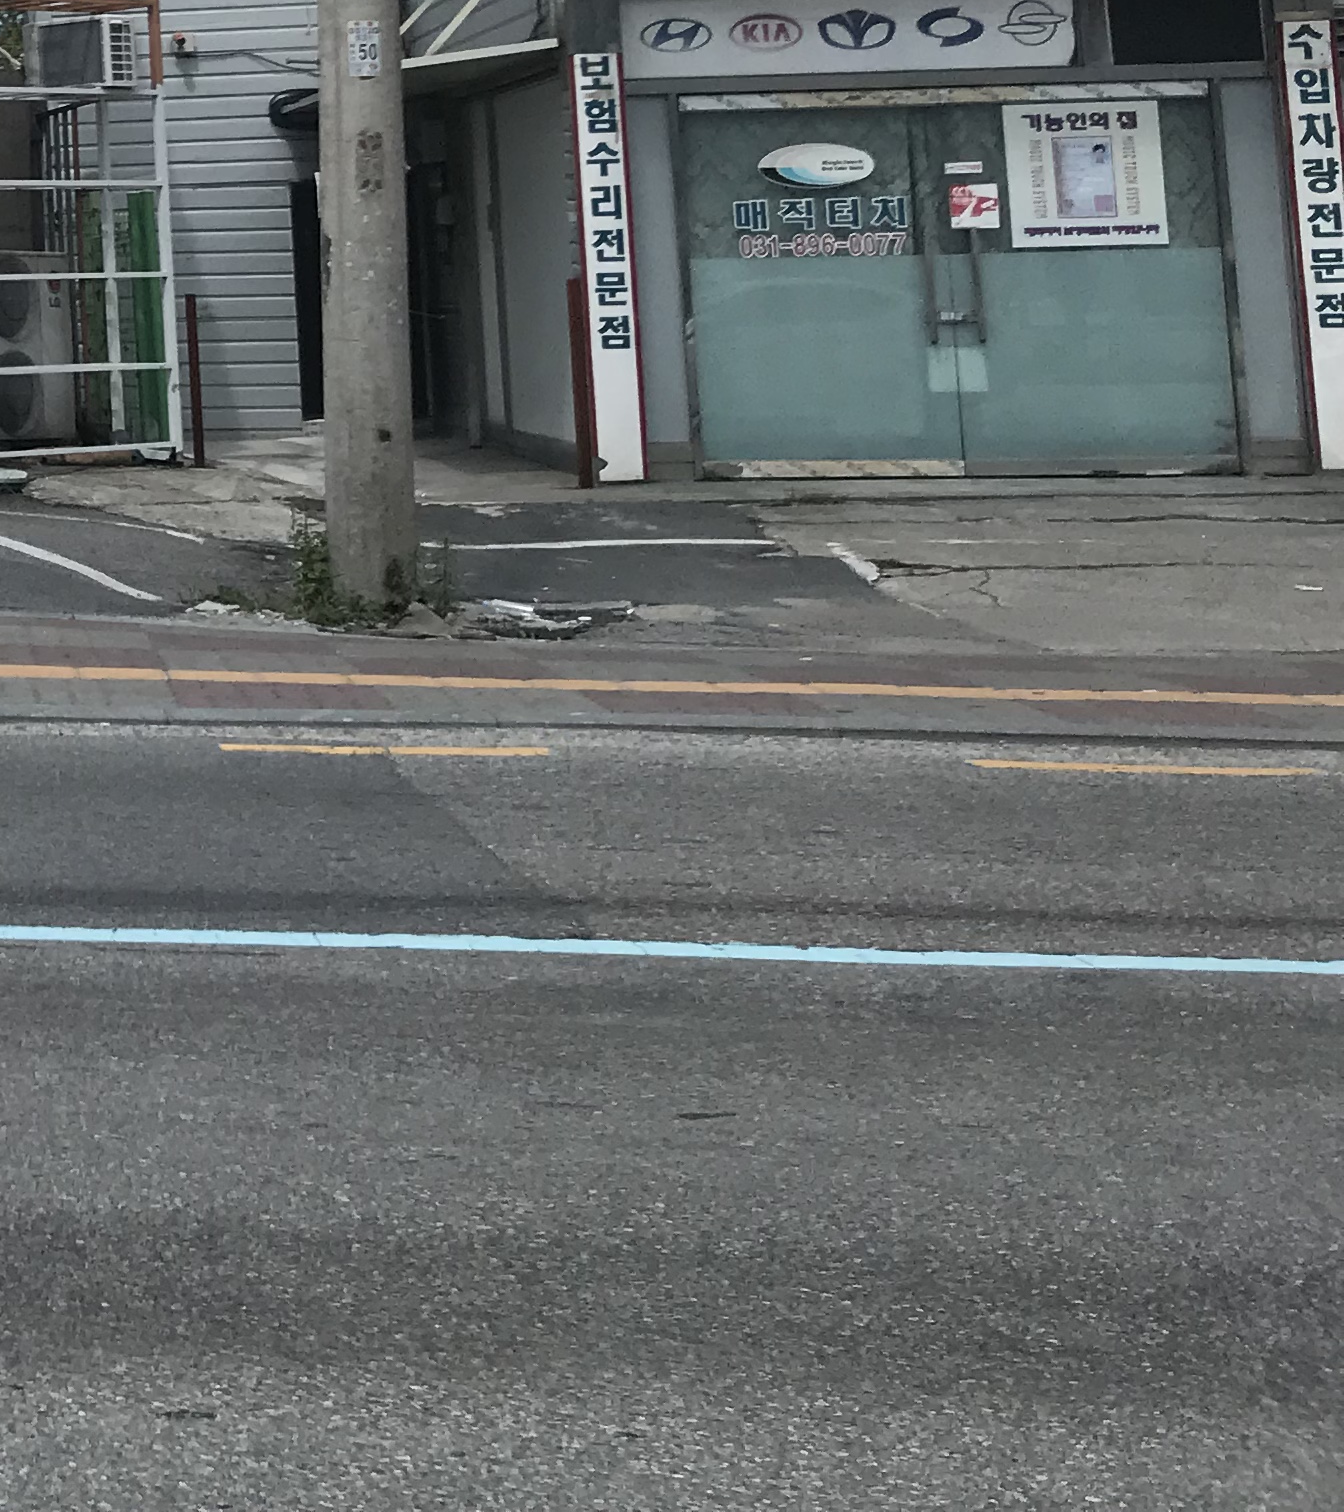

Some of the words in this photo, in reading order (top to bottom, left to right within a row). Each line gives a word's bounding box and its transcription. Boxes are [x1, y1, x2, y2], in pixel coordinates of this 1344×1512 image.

[741, 22, 791, 44] KIA
[359, 43, 377, 60] 50
[1287, 22, 1344, 330] 수입차량전문점
[579, 55, 633, 350] 보험수리전문점
[732, 195, 908, 231] 매직터치
[739, 232, 907, 258] 031-896-0077
